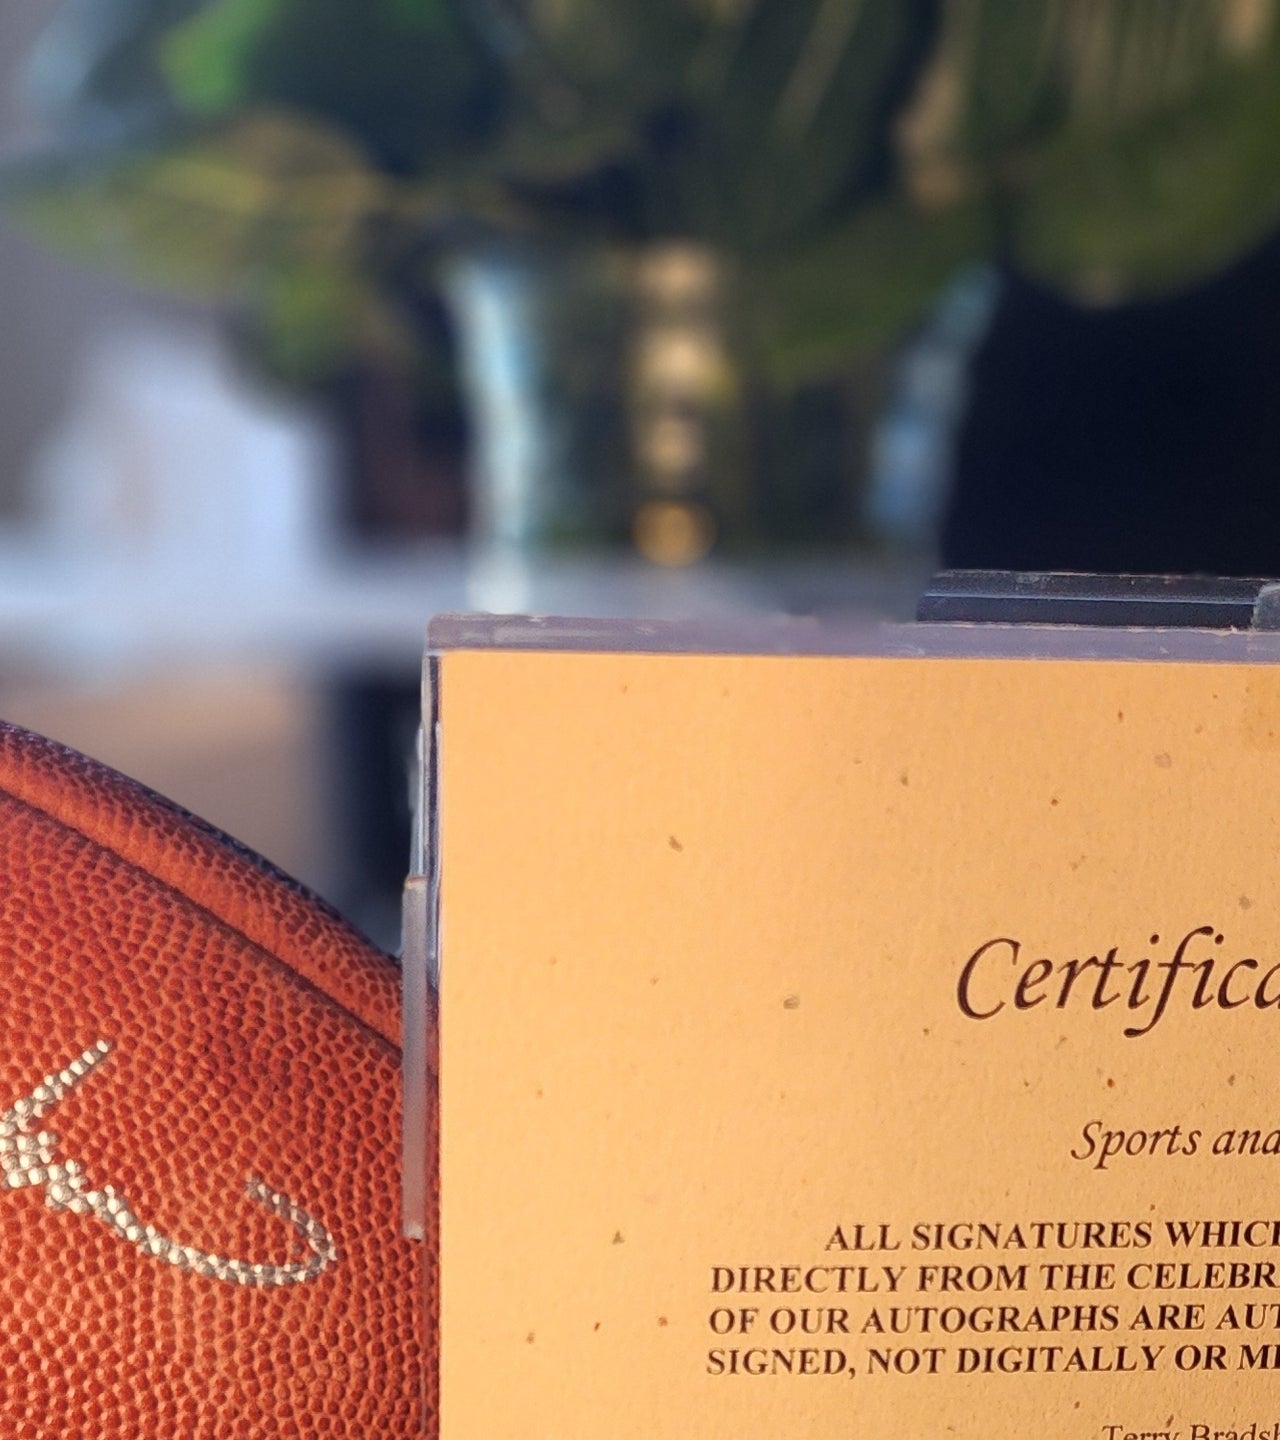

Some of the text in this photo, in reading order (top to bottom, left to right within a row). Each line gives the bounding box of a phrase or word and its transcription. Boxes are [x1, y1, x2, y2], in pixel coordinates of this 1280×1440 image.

[1070, 1119, 1204, 1169] Sports
[824, 1223, 901, 1252] ALL
[910, 1220, 1153, 1251] SIGNATURES
[711, 1264, 908, 1294] DIRECTLY
[917, 1262, 1030, 1293] FROM
[1039, 1261, 1117, 1292] THE
[708, 1306, 759, 1335] OF
[769, 1306, 851, 1335] OUR
[859, 1303, 1120, 1335] AUTOGRAPHS
[1128, 1302, 1206, 1332] ARE
[706, 1347, 857, 1381] SIGNED,
[865, 1347, 947, 1375] NOT
[955, 1344, 1167, 1374] DIGITALLY
[1174, 1343, 1228, 1372] OR
